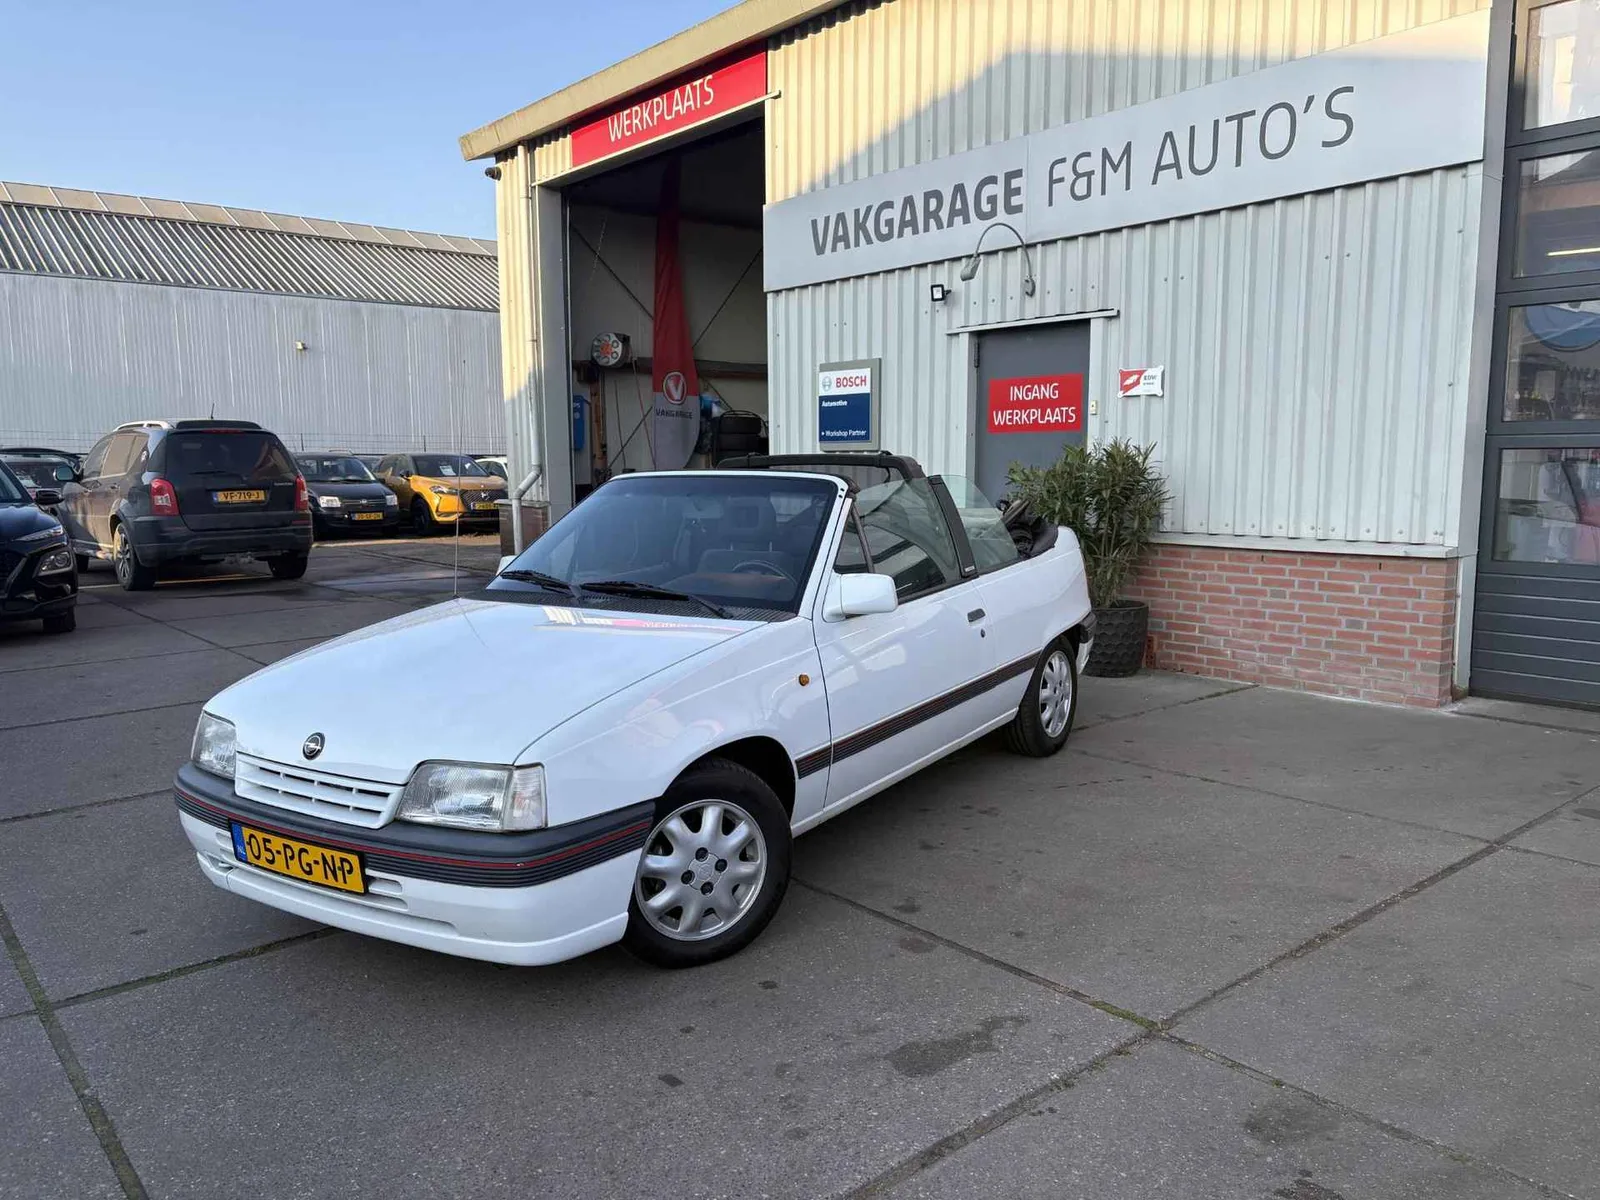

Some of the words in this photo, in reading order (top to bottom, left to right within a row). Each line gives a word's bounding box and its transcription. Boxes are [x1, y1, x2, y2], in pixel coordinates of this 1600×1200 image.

[608, 75, 714, 142] WERKPLAATS
[811, 168, 1024, 256] VAKGARAGE
[1048, 141, 1132, 207] F&M
[1151, 86, 1355, 185] AUTO'S
[836, 375, 867, 388] BOSCH
[1010, 383, 1059, 401] INGANG
[993, 407, 1076, 426] WERKPLAATS
[247, 833, 354, 885] 05-PG-NP
